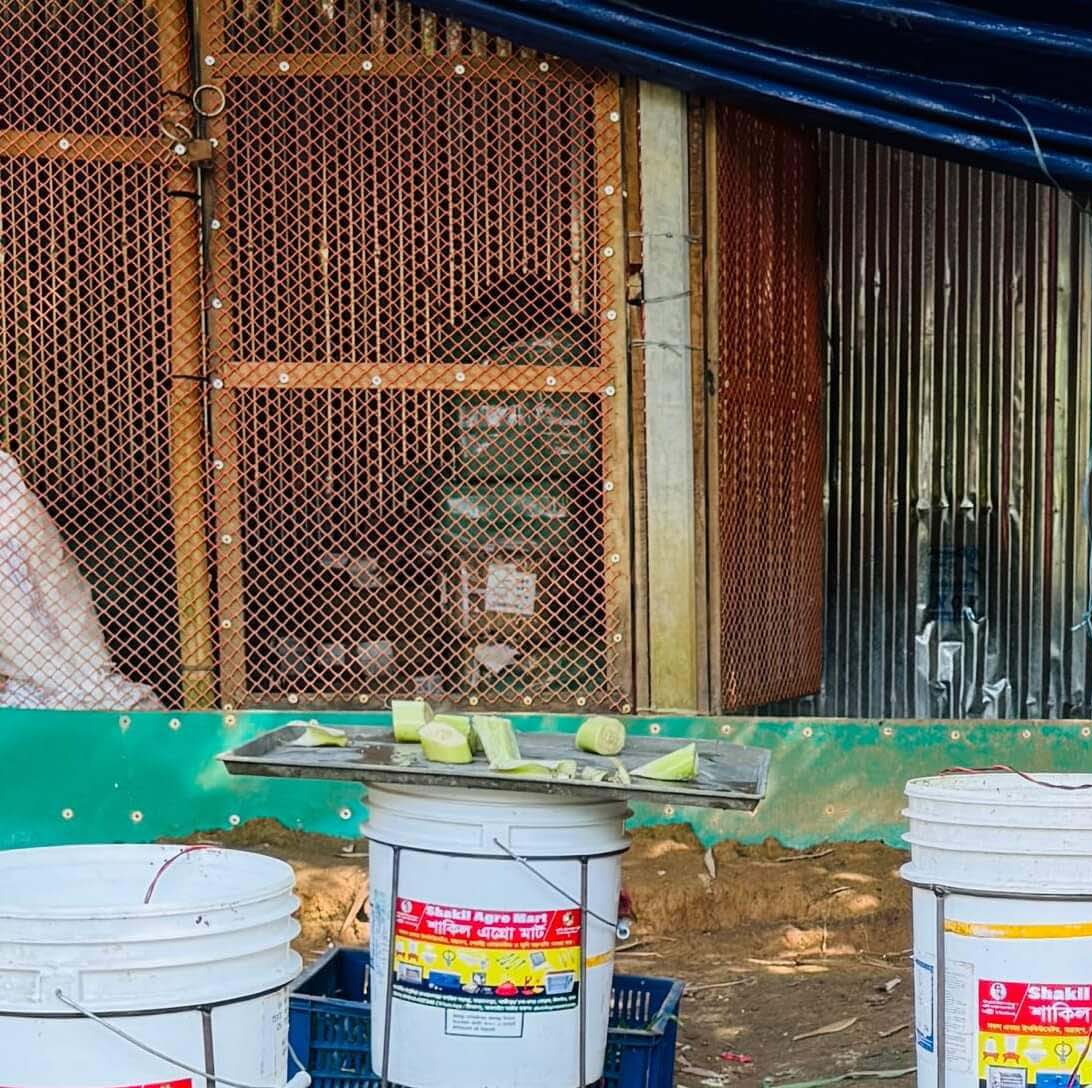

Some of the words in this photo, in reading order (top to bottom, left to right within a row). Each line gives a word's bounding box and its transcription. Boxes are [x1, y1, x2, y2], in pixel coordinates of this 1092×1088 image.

[425, 904, 471, 920] Shakil
[473, 911, 511, 925] Agro
[512, 912, 548, 924] Mart
[1027, 985, 1090, 1000] Shakil
[1028, 1001, 1092, 1023] শাকিল
